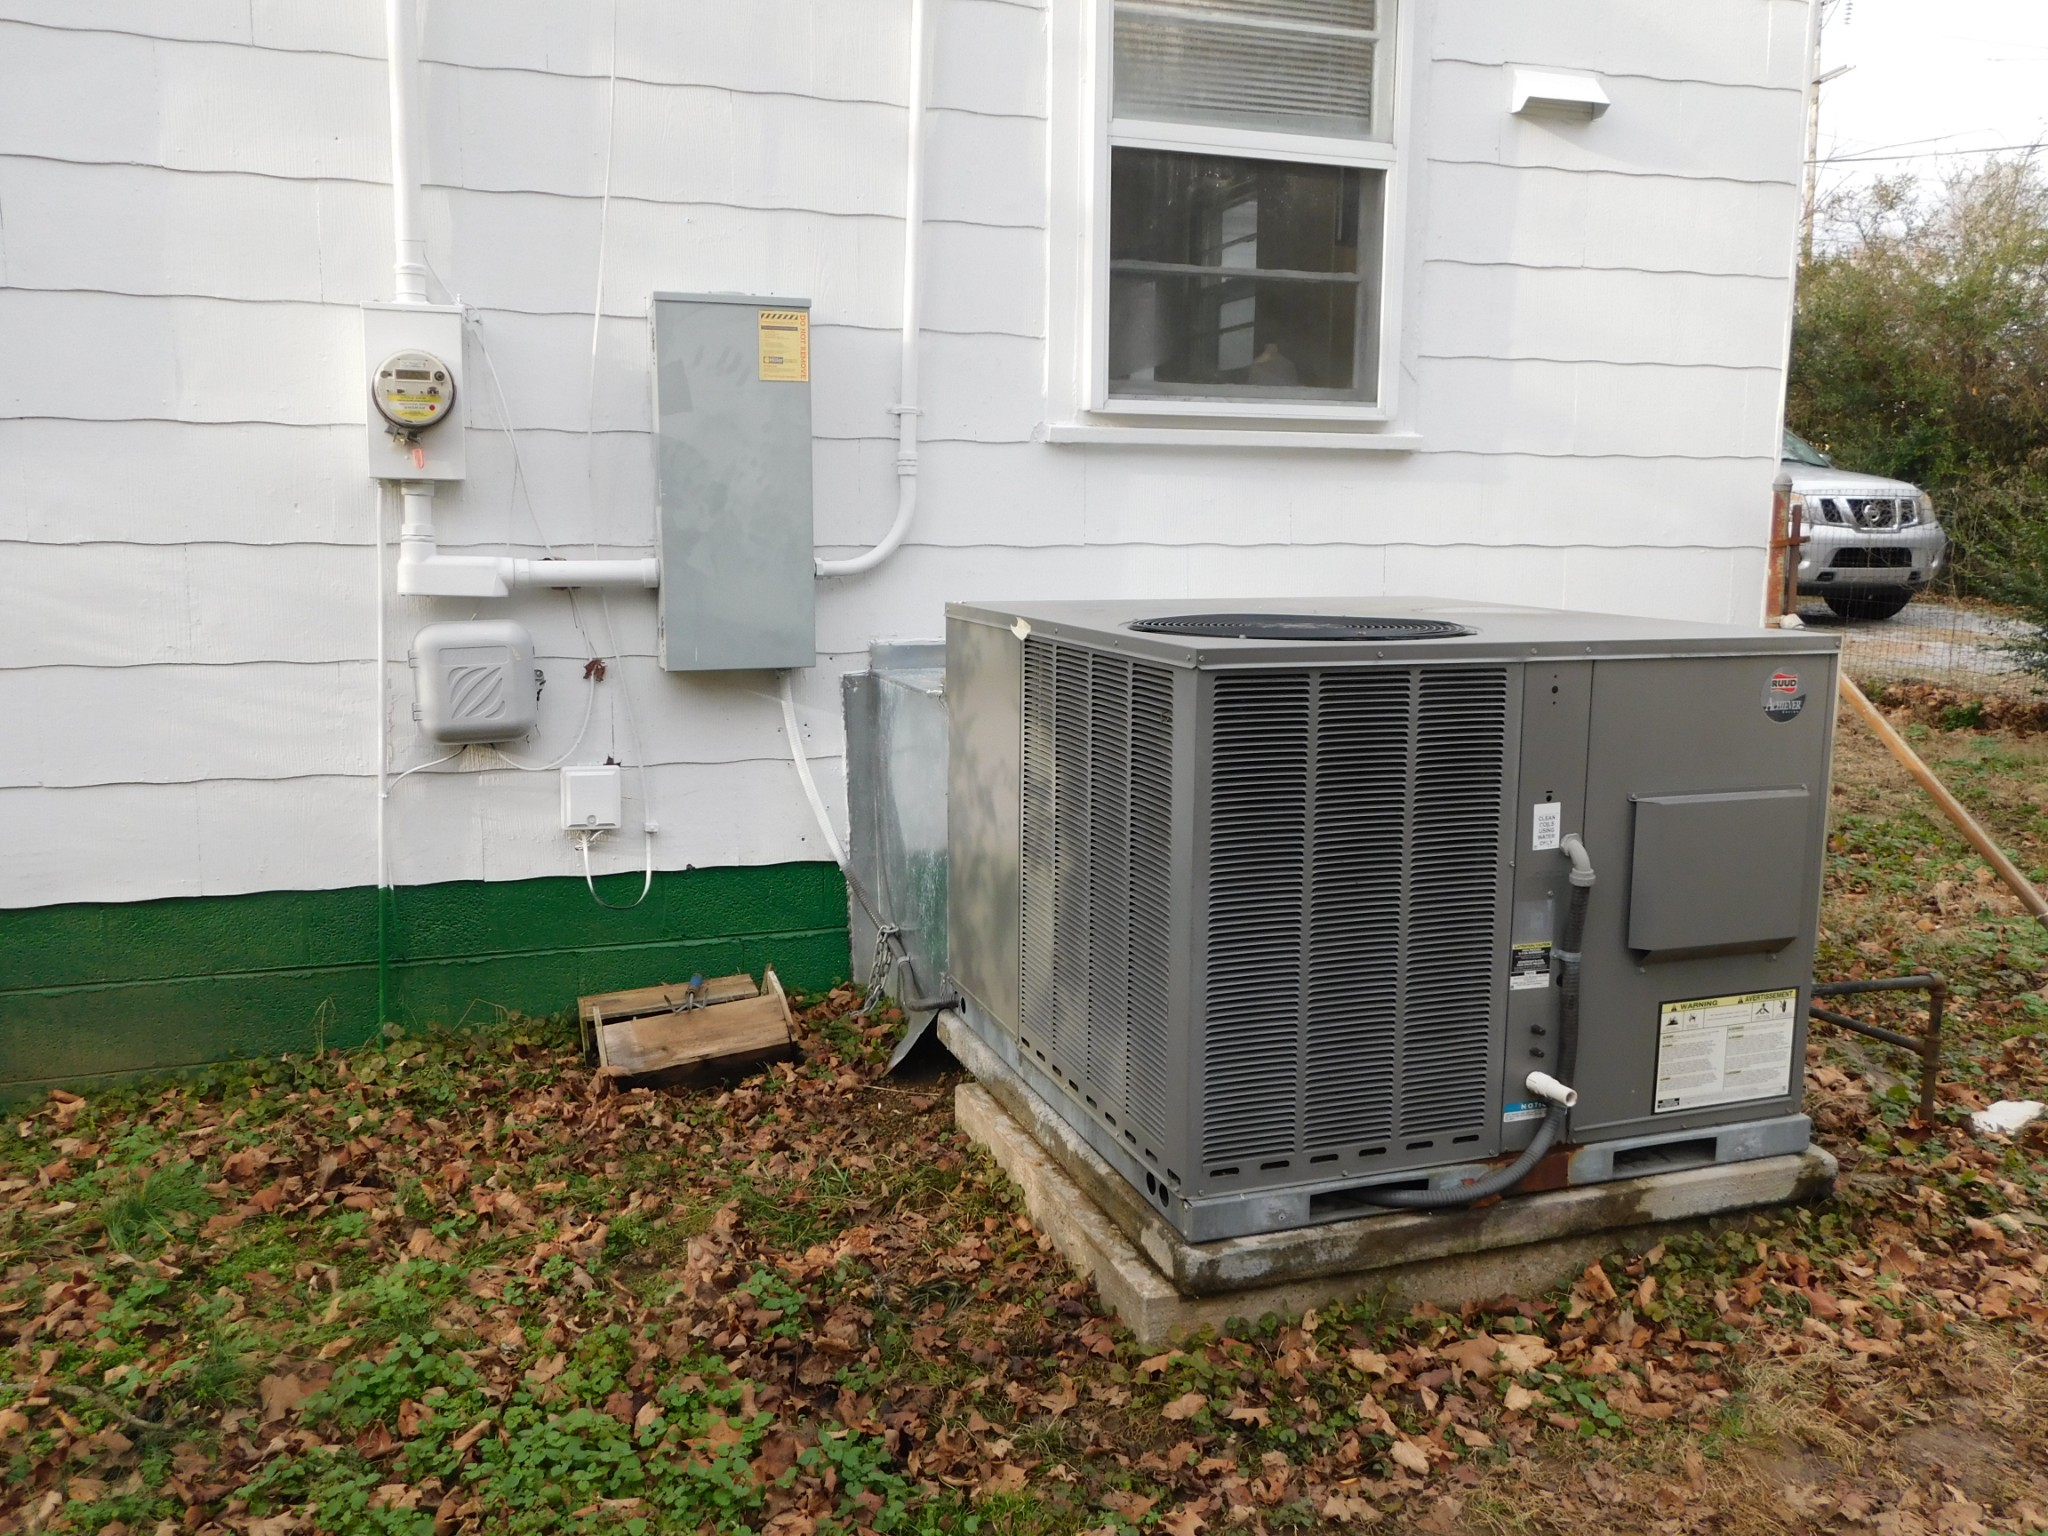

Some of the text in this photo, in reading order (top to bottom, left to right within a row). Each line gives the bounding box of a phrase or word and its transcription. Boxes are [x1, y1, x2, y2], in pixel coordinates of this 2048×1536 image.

[800, 314, 806, 327] DO
[1745, 990, 1793, 1002] AVERTISSEMENT
[1680, 1000, 1718, 1010] WARNING
